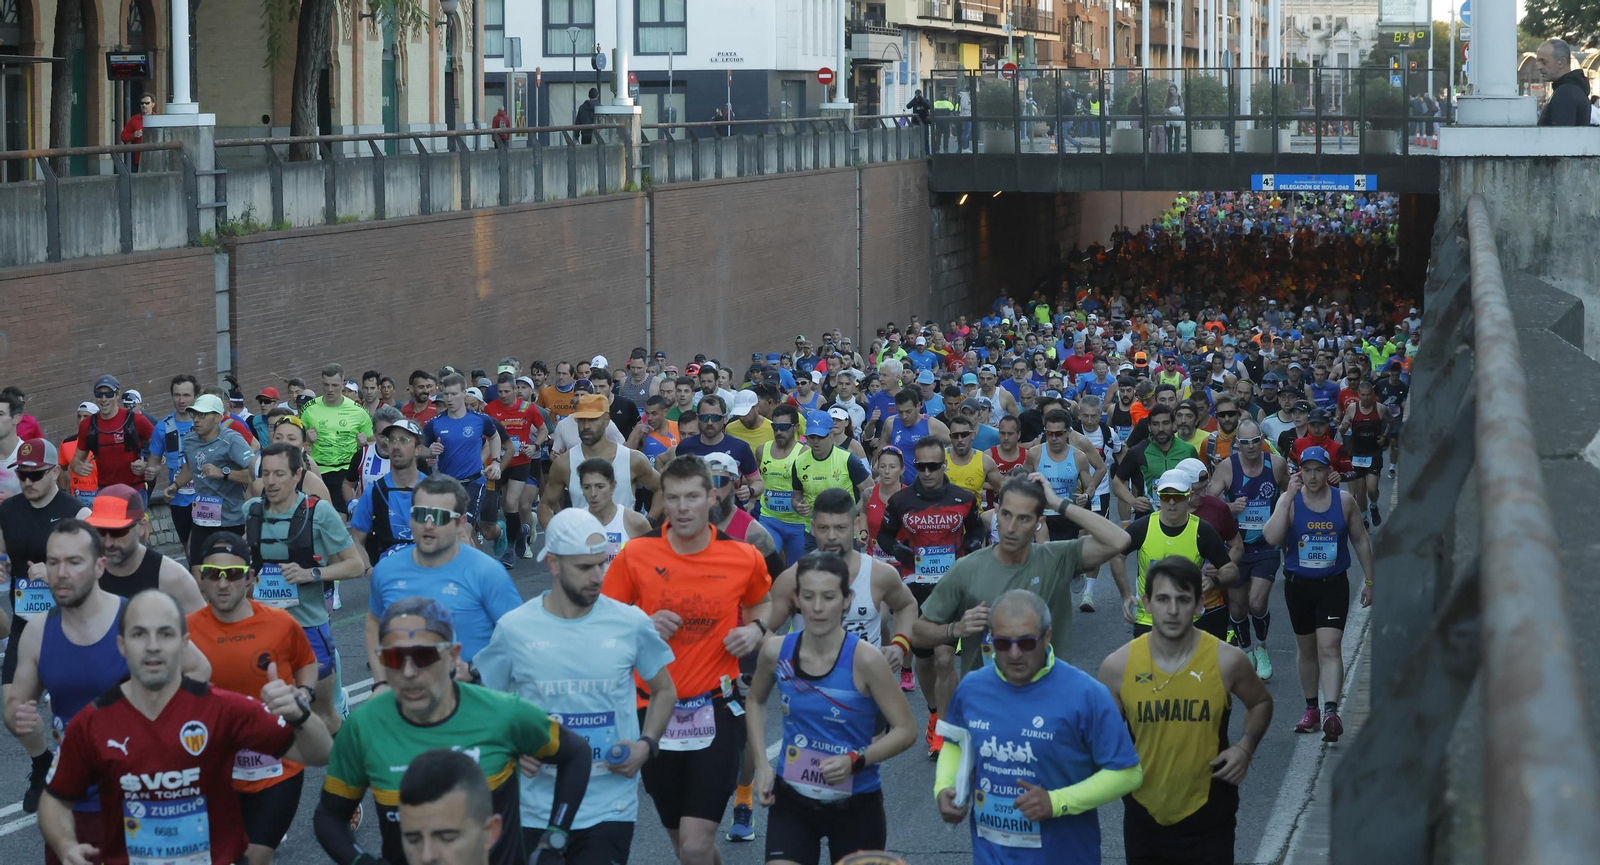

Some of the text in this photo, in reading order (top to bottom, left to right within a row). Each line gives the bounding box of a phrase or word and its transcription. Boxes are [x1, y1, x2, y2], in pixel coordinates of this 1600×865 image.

[909, 514, 959, 525] SPARTANS
[1245, 515, 1263, 523] MARK
[1307, 521, 1334, 530] GREG
[1307, 552, 1327, 560] GREG
[920, 565, 950, 574] CARLOS
[258, 588, 292, 599] THOMAS
[23, 602, 52, 612] JACOB
[217, 633, 256, 643] GIVOVA
[1137, 698, 1211, 723] JAMAICA
[567, 715, 607, 726] ZURICH
[677, 727, 715, 738] FANCLUB
[1021, 728, 1054, 740] ZURICH
[811, 740, 848, 754] ZURICH
[237, 754, 263, 766] ERIK
[983, 762, 1036, 778] #imparables
[119, 766, 201, 792] $VCF
[124, 787, 200, 800] FAN TOKEN
[150, 802, 197, 817] ZURICH
[994, 803, 1014, 815] 5375
[980, 812, 1033, 833] ANDARÍN
[154, 827, 179, 837] 6683
[127, 845, 154, 857] SARA
[156, 846, 163, 856] Y
